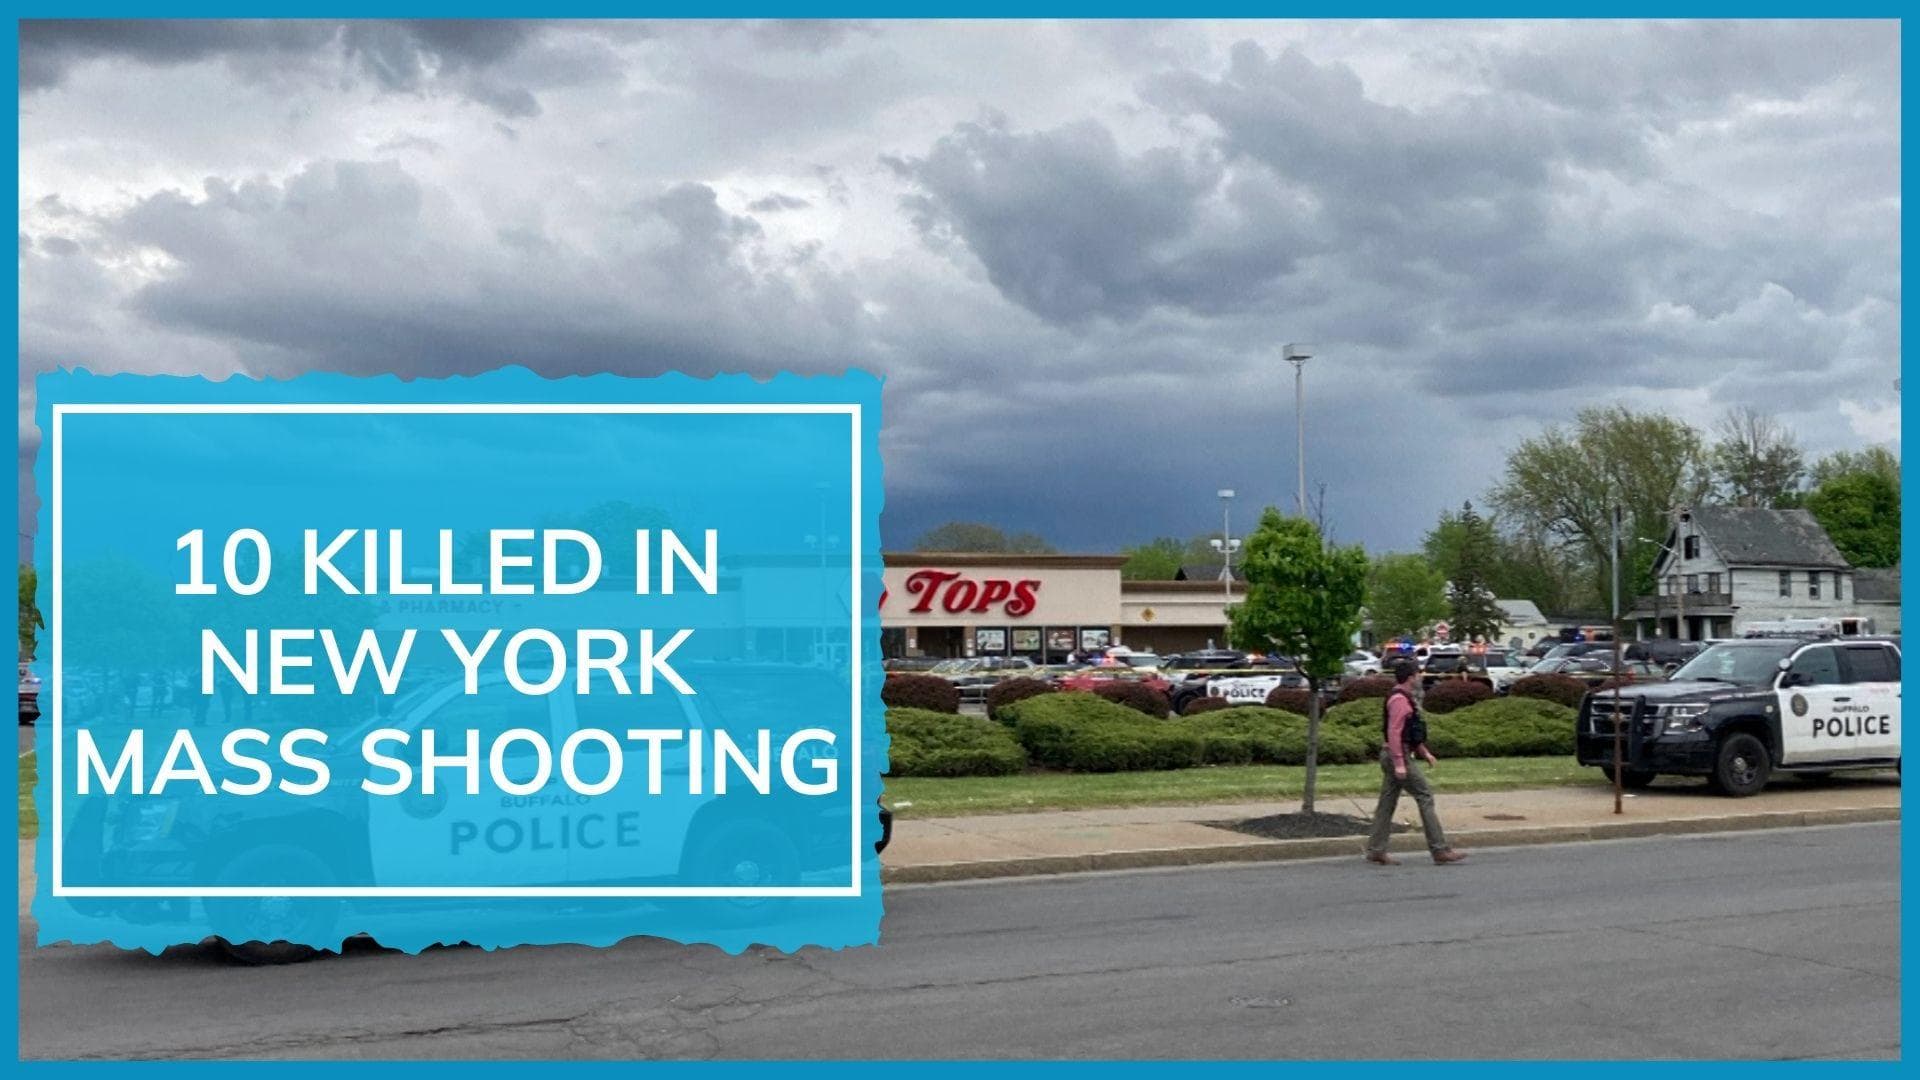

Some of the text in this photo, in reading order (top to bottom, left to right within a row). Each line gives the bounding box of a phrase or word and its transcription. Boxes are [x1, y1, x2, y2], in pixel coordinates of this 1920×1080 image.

[399, 599, 504, 614] PHARMACY
[905, 570, 1042, 618] TOPS
[1812, 714, 1890, 739] POLICE
[499, 793, 592, 809] BUFFALO
[450, 811, 641, 855] POLICE
